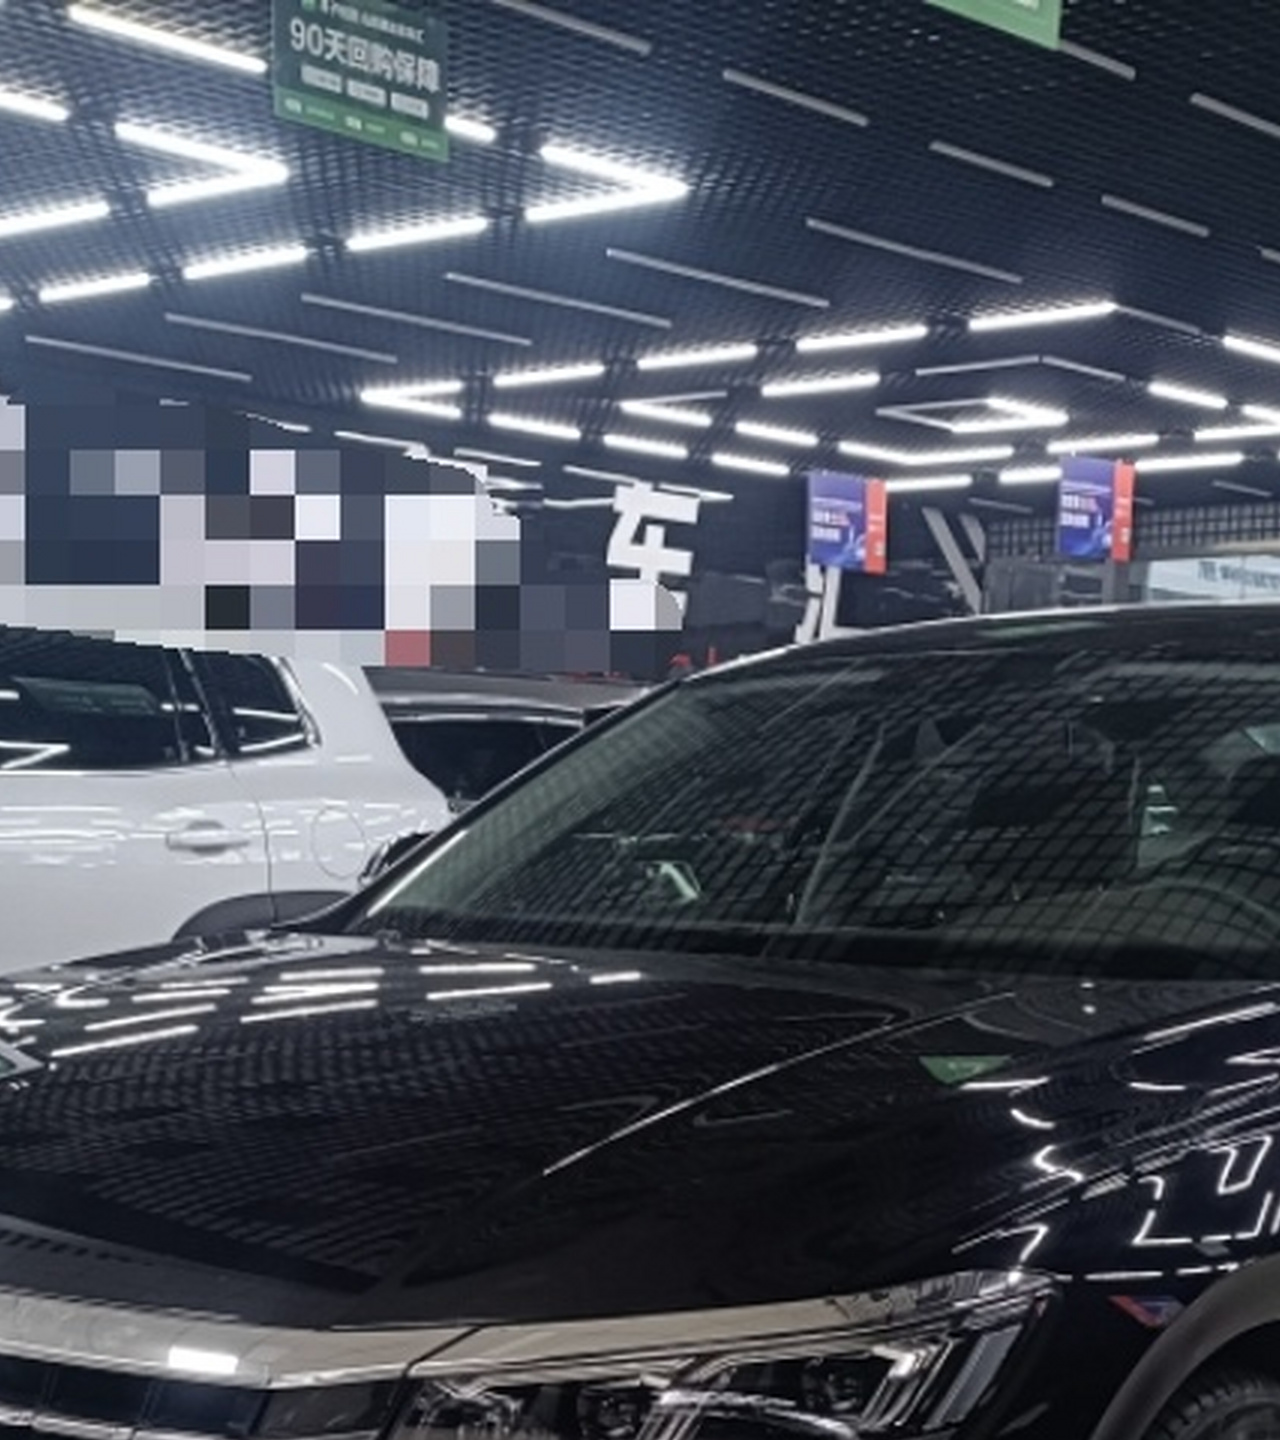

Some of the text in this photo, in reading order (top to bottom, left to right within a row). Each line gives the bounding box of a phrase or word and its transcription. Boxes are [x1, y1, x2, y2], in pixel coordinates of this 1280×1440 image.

[289, 16, 441, 94] 90天回购保障
